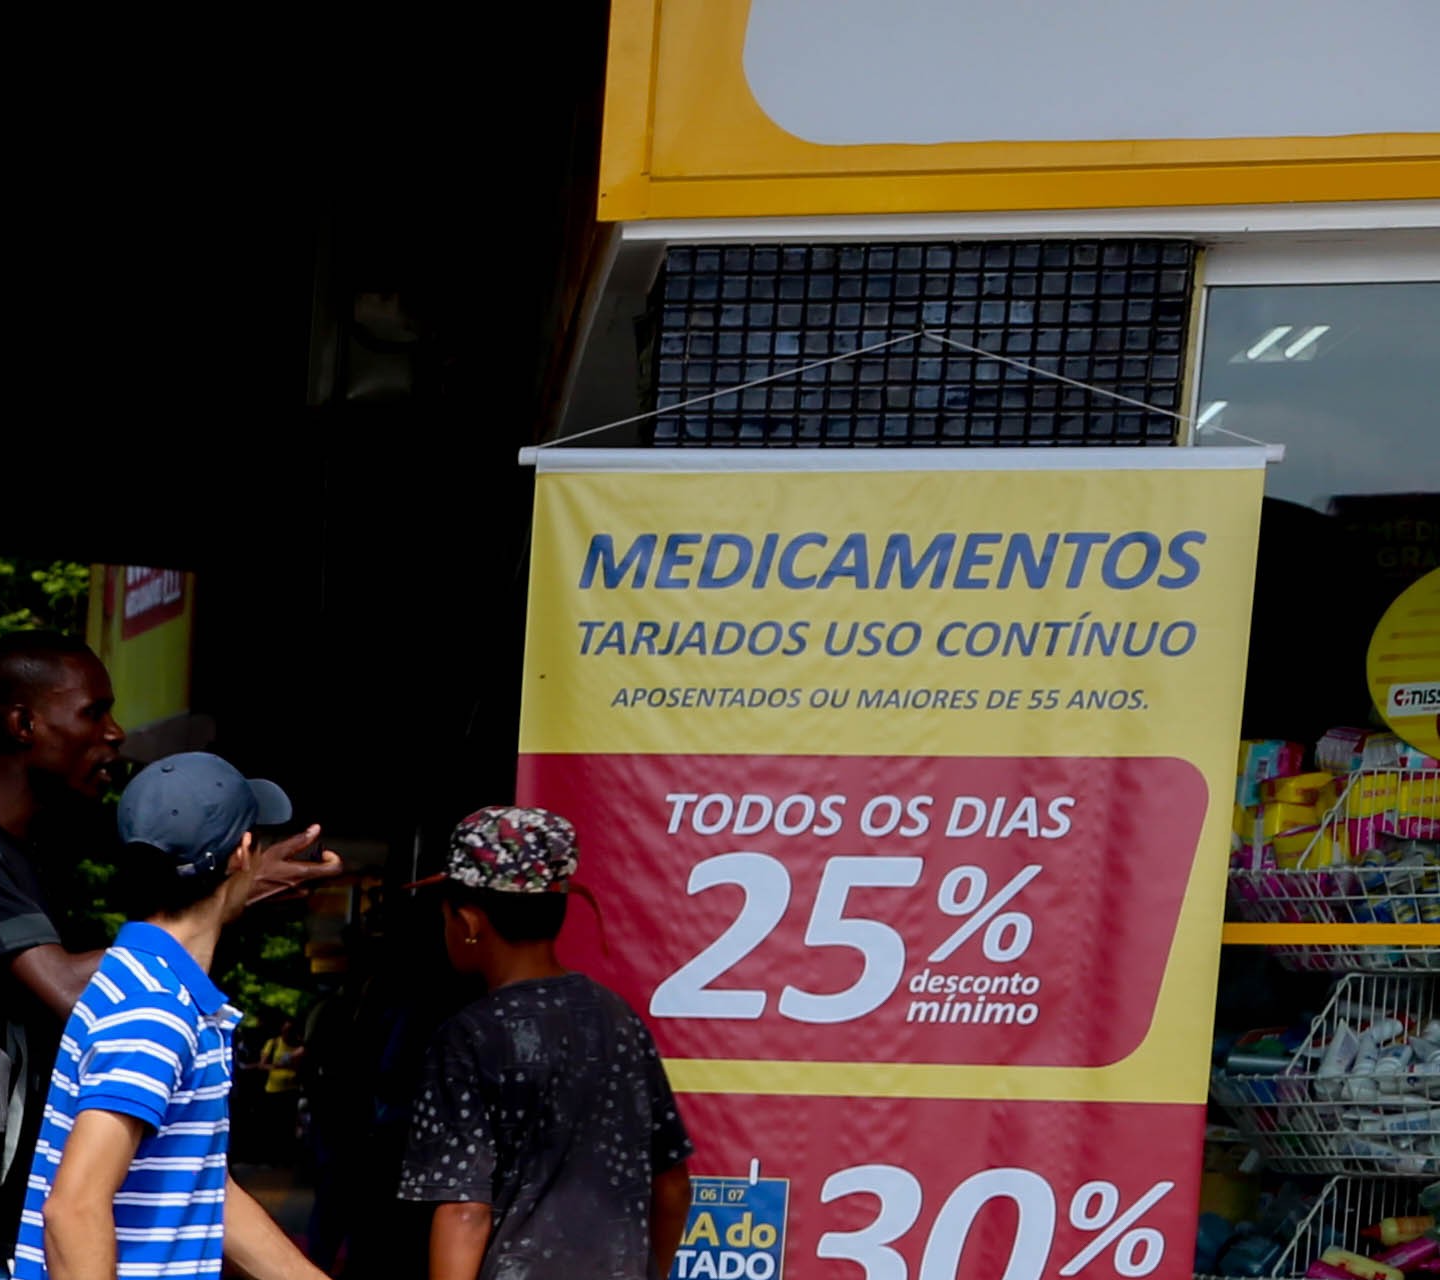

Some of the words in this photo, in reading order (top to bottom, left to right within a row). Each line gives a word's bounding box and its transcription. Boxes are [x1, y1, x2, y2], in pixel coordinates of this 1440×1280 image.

[578, 532, 1207, 590] MEDICAMENTOS
[578, 621, 811, 656] TARJADOS
[824, 621, 922, 657] USO
[936, 611, 1197, 657] CONTÍNUO
[611, 688, 802, 709] APOSENTADOS
[809, 688, 850, 708] OU
[856, 689, 979, 710] MAIORES
[986, 689, 1022, 710] DE
[1027, 689, 1060, 710] 55
[1066, 690, 1149, 711] ANOS.
[665, 793, 846, 837] TODOS
[859, 793, 934, 838] OS
[945, 797, 1076, 839] DIAS
[649, 852, 1043, 1024] 25%
[908, 969, 1040, 997] desconto
[905, 995, 1039, 1026] mínimo
[700, 1189, 717, 1201] 06
[727, 1189, 745, 1201] 07
[726, 1212, 776, 1249] do
